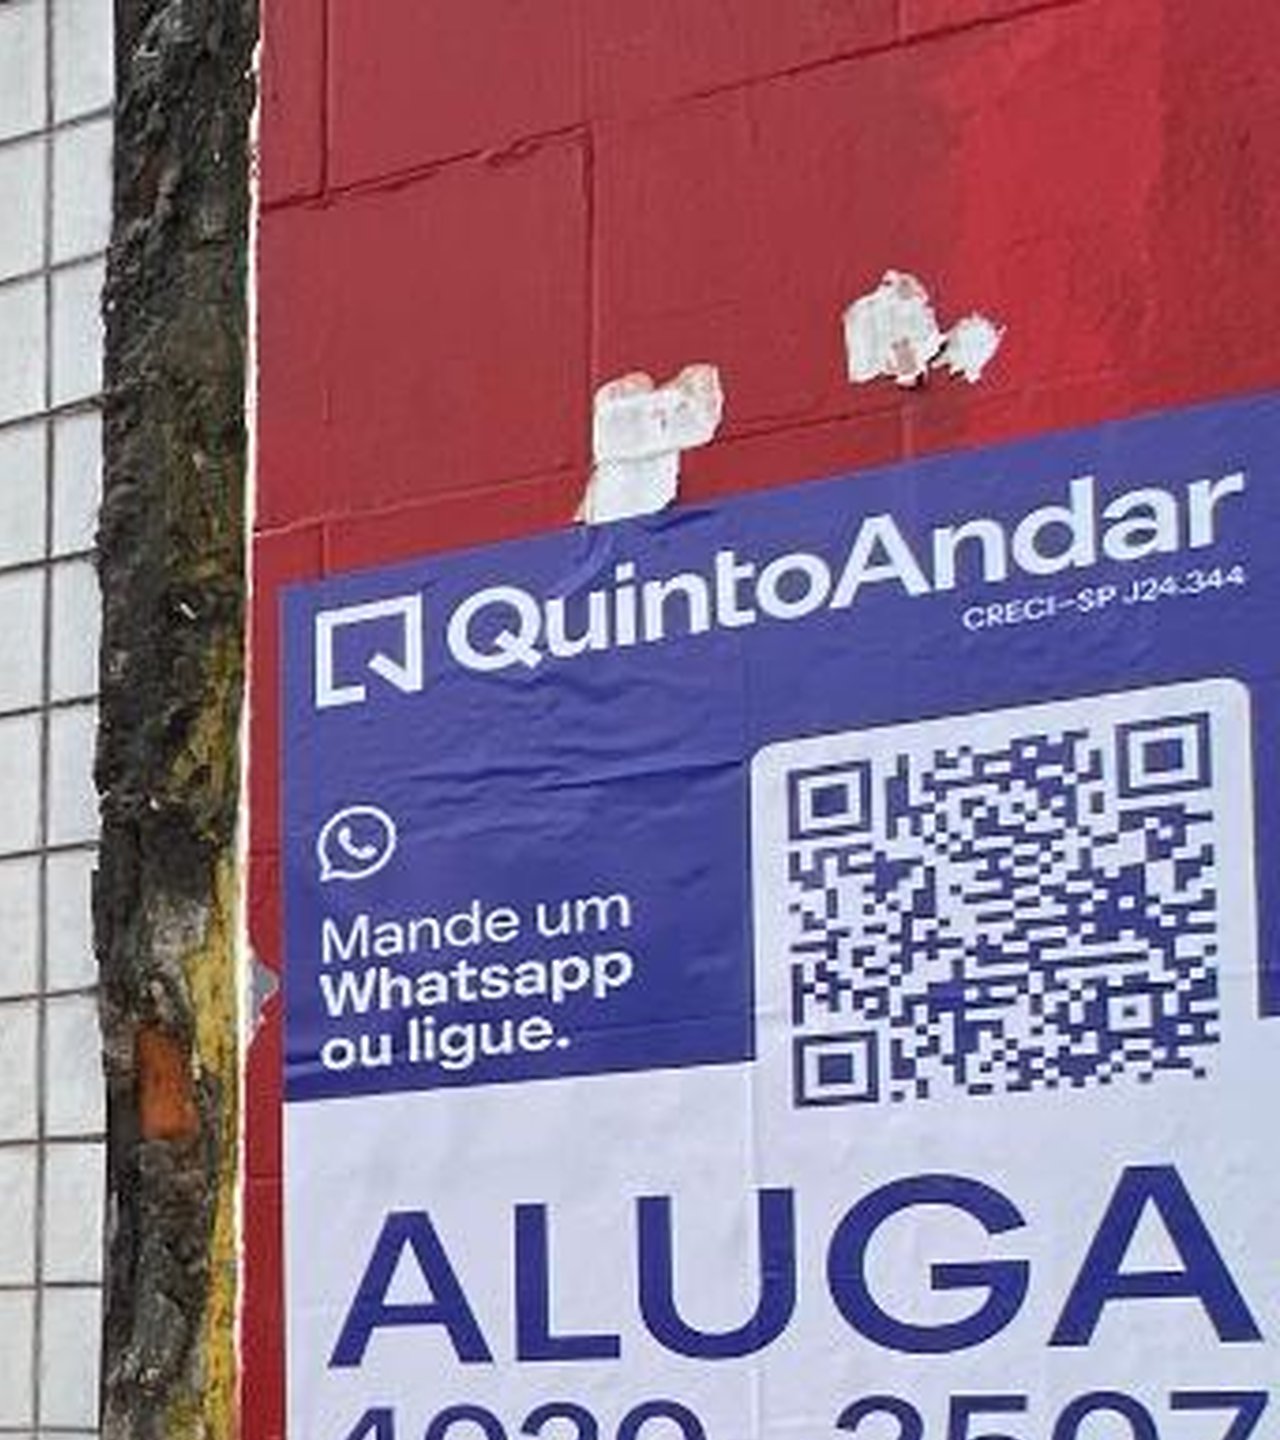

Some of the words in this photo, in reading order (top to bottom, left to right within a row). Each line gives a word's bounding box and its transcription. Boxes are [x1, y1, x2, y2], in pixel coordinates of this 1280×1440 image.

[446, 470, 1248, 673] QuintoAndar
[321, 901, 520, 963] Mande
[534, 889, 633, 944] um
[321, 945, 635, 1018] Whatsapp
[321, 1033, 395, 1073] ou
[407, 1009, 572, 1073] ligue.
[326, 1162, 1264, 1369] ALUGA
